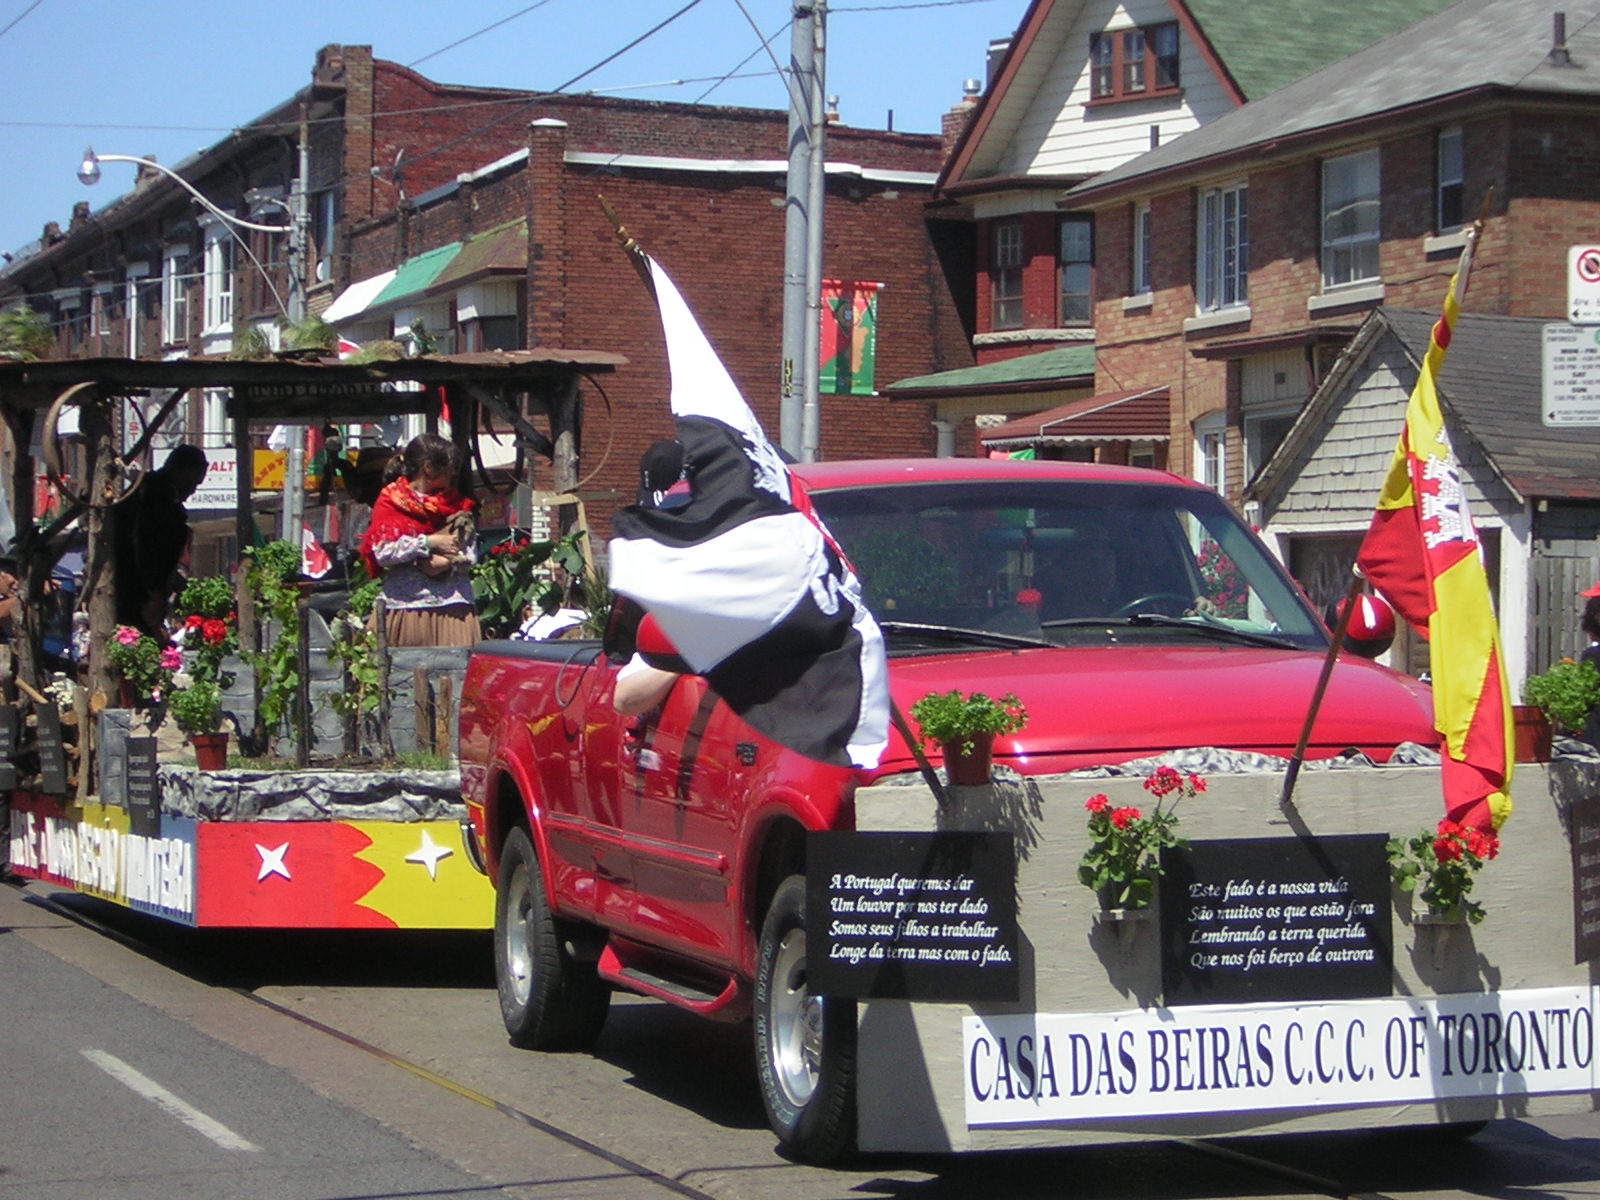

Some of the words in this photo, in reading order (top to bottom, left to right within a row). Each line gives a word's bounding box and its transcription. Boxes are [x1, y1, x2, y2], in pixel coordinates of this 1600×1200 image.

[191, 494, 236, 503] HARDWARE
[829, 874, 841, 889] A
[844, 873, 898, 895] Portugal
[897, 878, 951, 896] queremos
[953, 874, 974, 890] dar
[1189, 883, 1221, 898] Este
[1222, 879, 1254, 902] fado
[1256, 880, 1265, 896] é
[1267, 884, 1277, 895] a
[1280, 882, 1316, 895] nossa
[1319, 876, 1348, 893] vida
[830, 897, 855, 912] Um
[856, 896, 894, 912] louvor
[894, 901, 916, 919] por
[917, 902, 938, 913] nos
[939, 901, 958, 914] ter
[959, 897, 988, 914] dado
[1187, 905, 1213, 922] São
[1217, 904, 1264, 920] muitos
[1266, 906, 1281, 918] os
[1283, 905, 1307, 923] que
[1310, 901, 1344, 917] estão
[1344, 899, 1375, 922] fora
[829, 920, 867, 936] Somos
[868, 924, 894, 935] seus
[894, 919, 929, 941] filhos
[931, 925, 940, 936] a
[942, 920, 998, 937] trabalhar
[1189, 925, 1266, 944] Lembrando
[1268, 930, 1278, 941] a
[1281, 928, 1314, 941] terra
[1317, 922, 1366, 945] querida
[829, 943, 867, 964] Longe
[868, 942, 884, 958] da
[887, 947, 916, 959] terra
[918, 948, 942, 960] mas
[944, 949, 970, 960] com
[971, 949, 980, 960] o
[979, 944, 1011, 967] fado.
[1191, 952, 1218, 969] Que
[1221, 953, 1245, 965] nos
[1243, 948, 1266, 971] foi
[1269, 947, 1304, 967] berço
[1307, 946, 1322, 962] de
[1325, 949, 1374, 962] outrora
[970, 1035, 1060, 1102] CASA
[1068, 1030, 1137, 1097] DAS
[1147, 1023, 1274, 1092] BEIRAS
[1284, 1019, 1374, 1086] C.C.C.
[1385, 1016, 1427, 1080] OF
[1437, 1006, 1593, 1076] TORONTO
